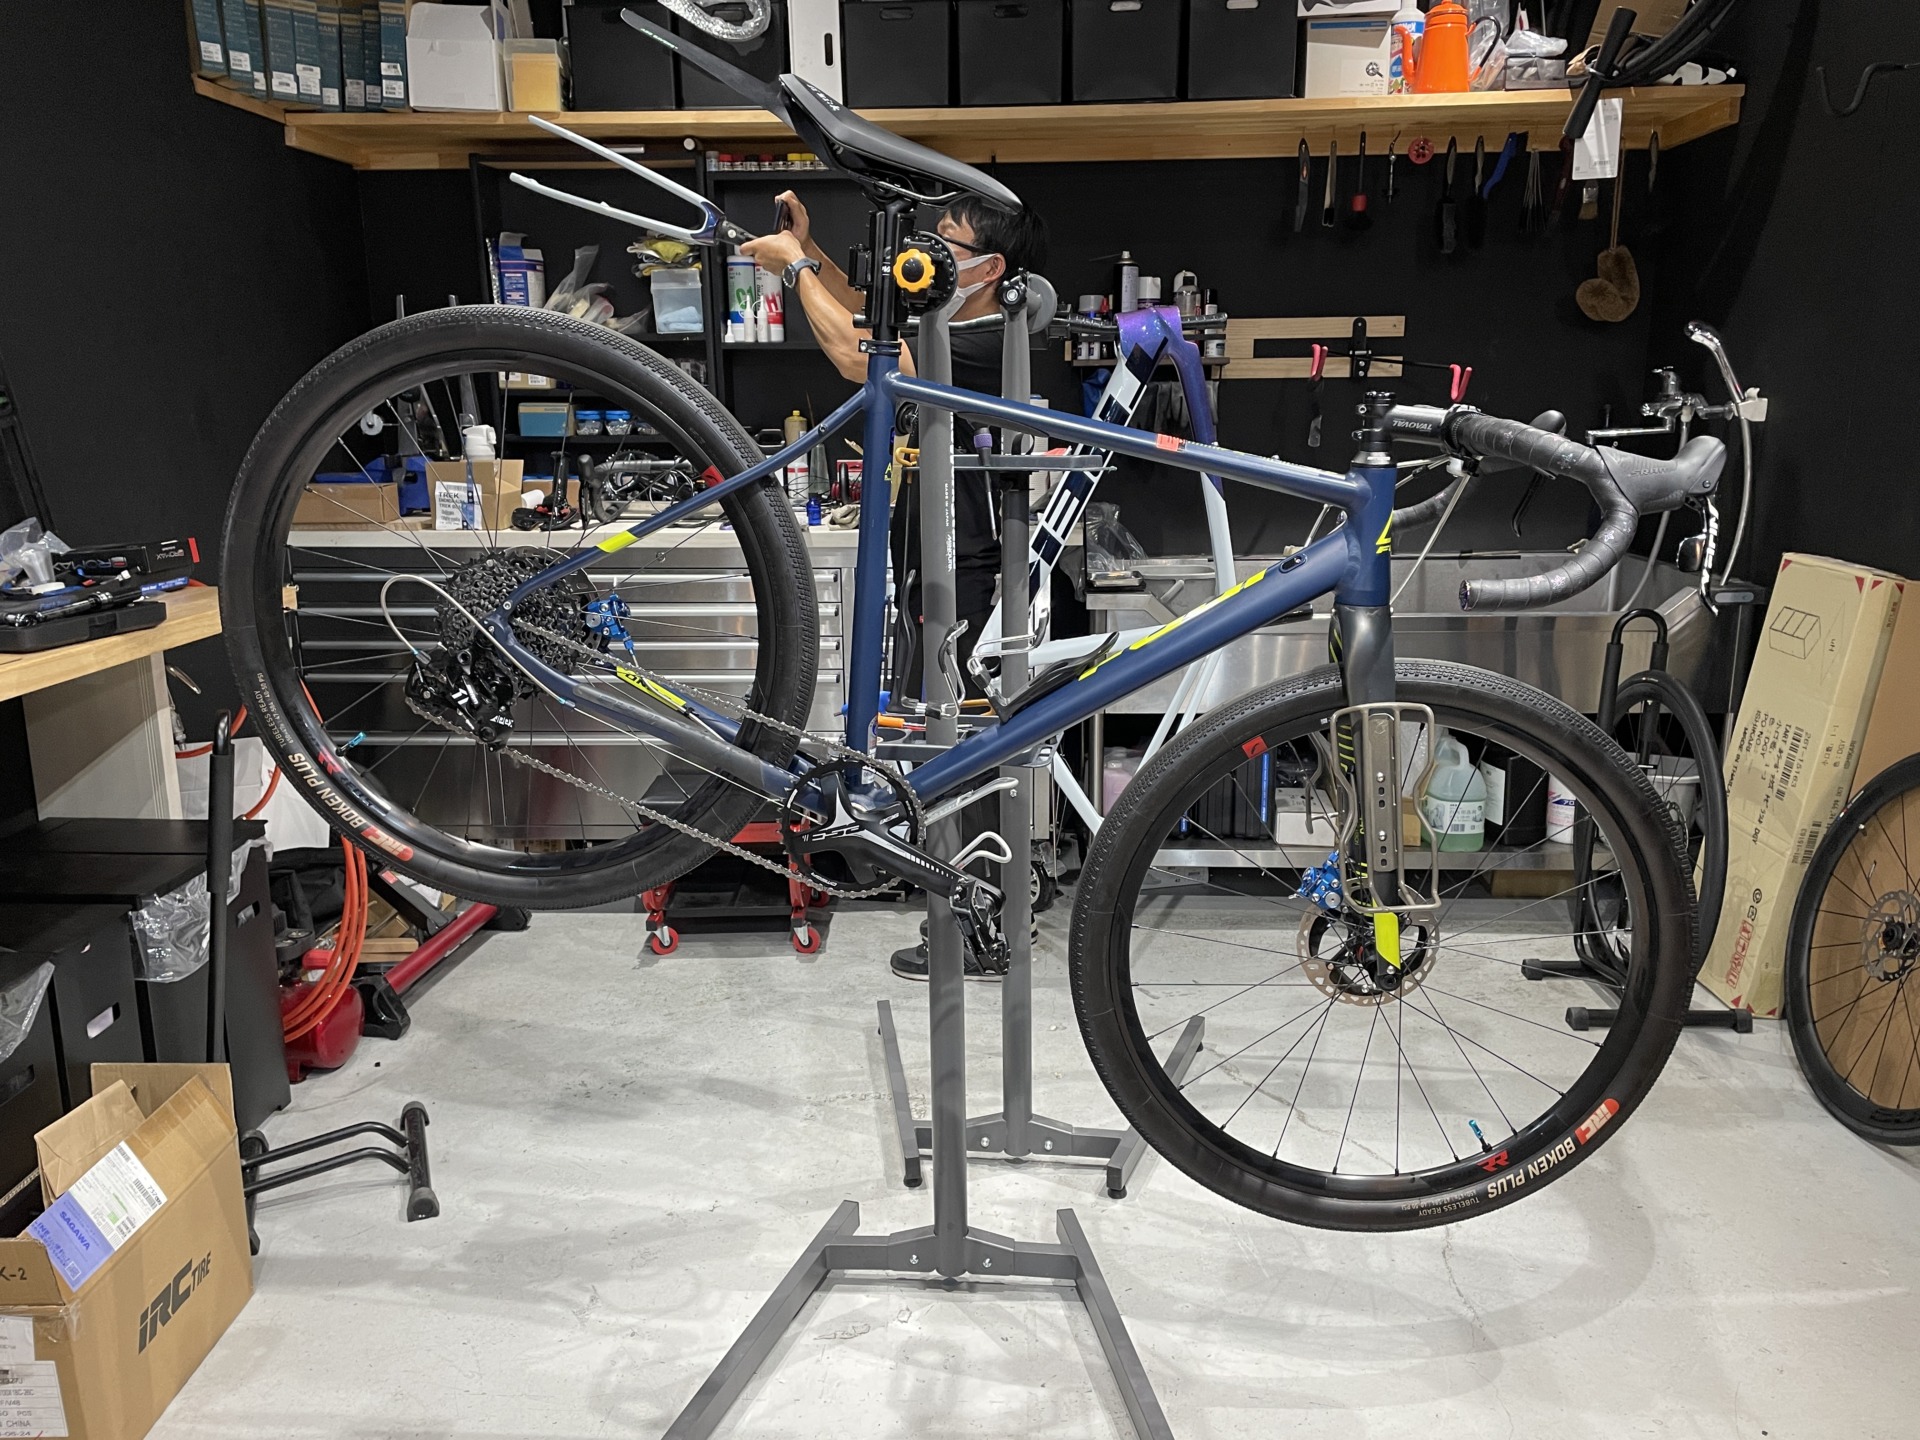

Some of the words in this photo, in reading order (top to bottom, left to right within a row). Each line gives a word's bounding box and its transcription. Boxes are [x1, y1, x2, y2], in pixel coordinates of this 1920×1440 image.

[254, 689, 269, 714] READY
[263, 711, 289, 748] TUBELESS
[287, 752, 324, 788] PLUS
[316, 786, 368, 829] BOKEN
[1528, 1136, 1577, 1180] BOKEN
[1487, 1172, 1526, 1199] PLUS
[1418, 1207, 1443, 1217] READY
[1443, 1196, 1481, 1212] TUBELESS
[59, 1211, 91, 1251] SAGAWA
[190, 1250, 213, 1293] TIRE
